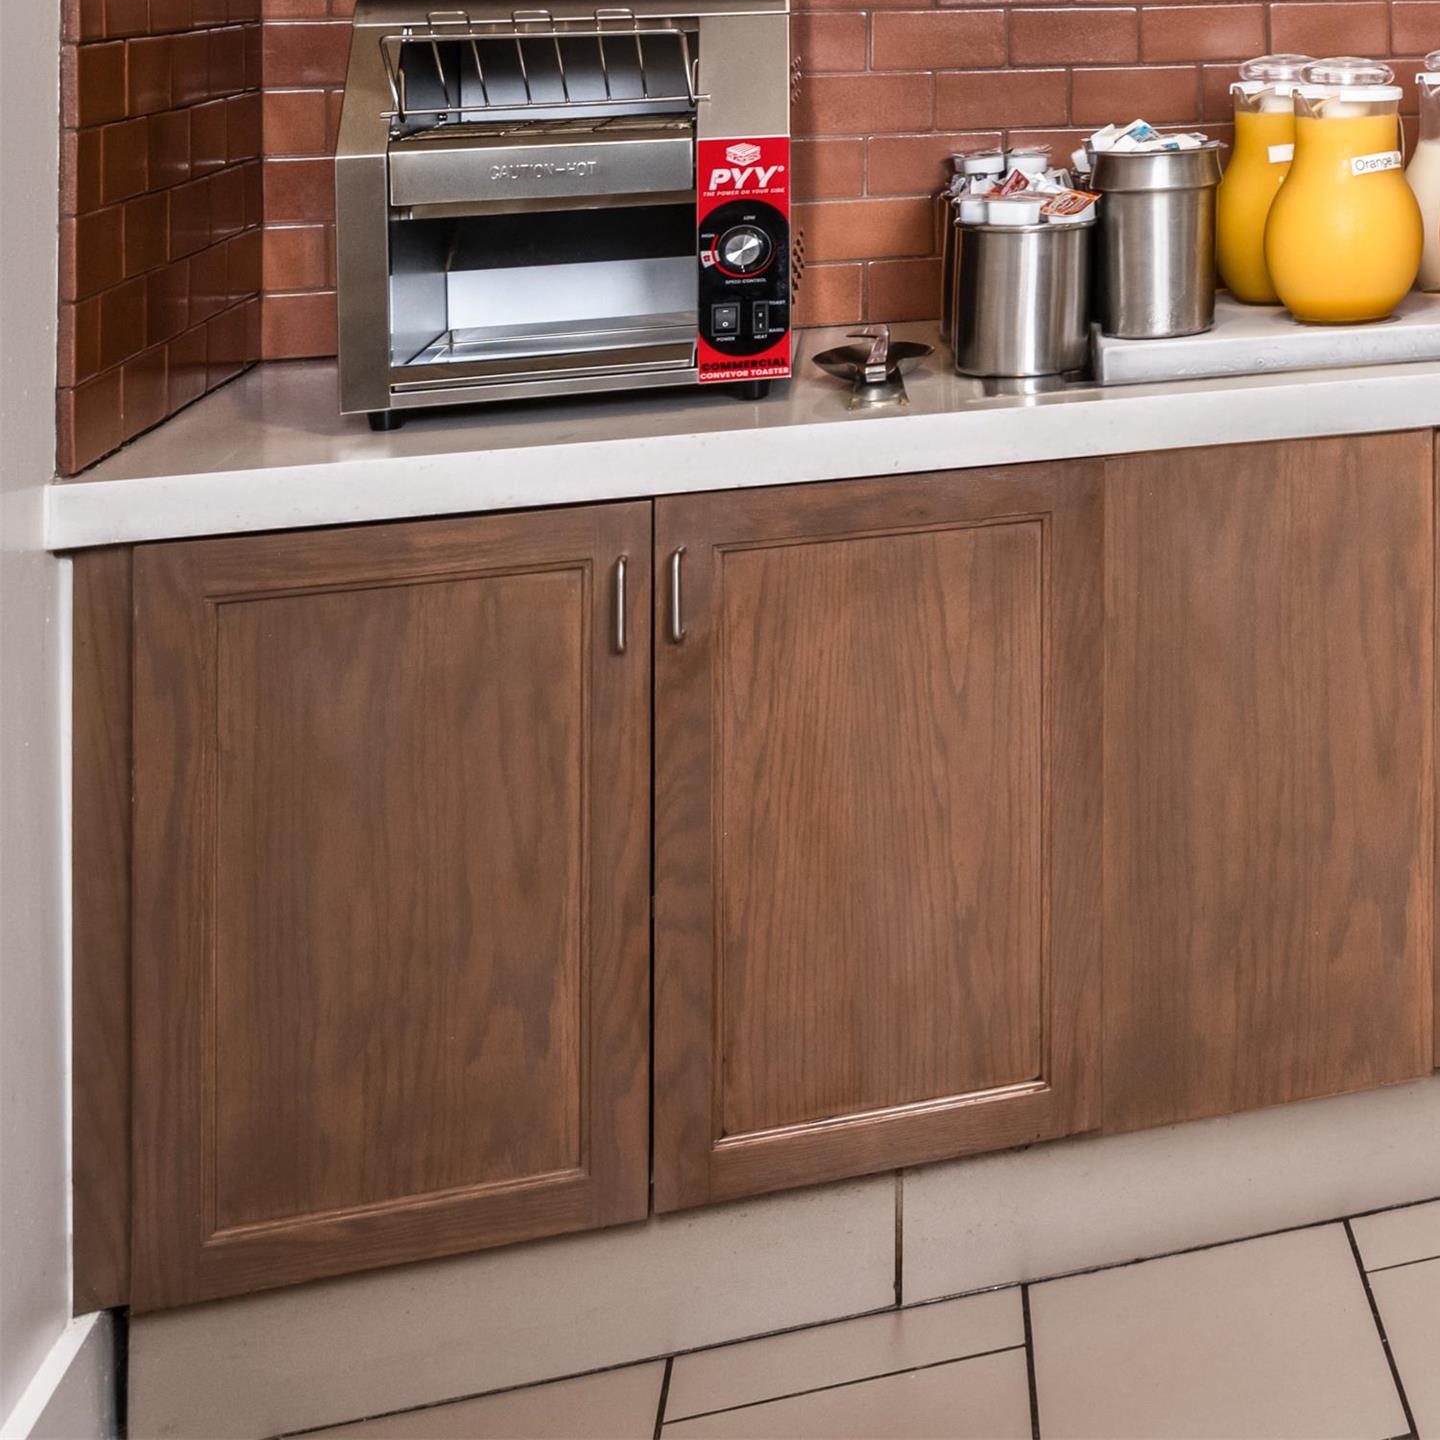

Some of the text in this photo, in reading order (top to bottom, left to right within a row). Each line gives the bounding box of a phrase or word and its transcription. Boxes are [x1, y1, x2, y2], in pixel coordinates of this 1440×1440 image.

[1355, 156, 1393, 171] Orange
[716, 189, 740, 197] POWER
[701, 358, 787, 371] COMMERCIAL
[700, 367, 790, 380] CONVEYOR TOASTER
